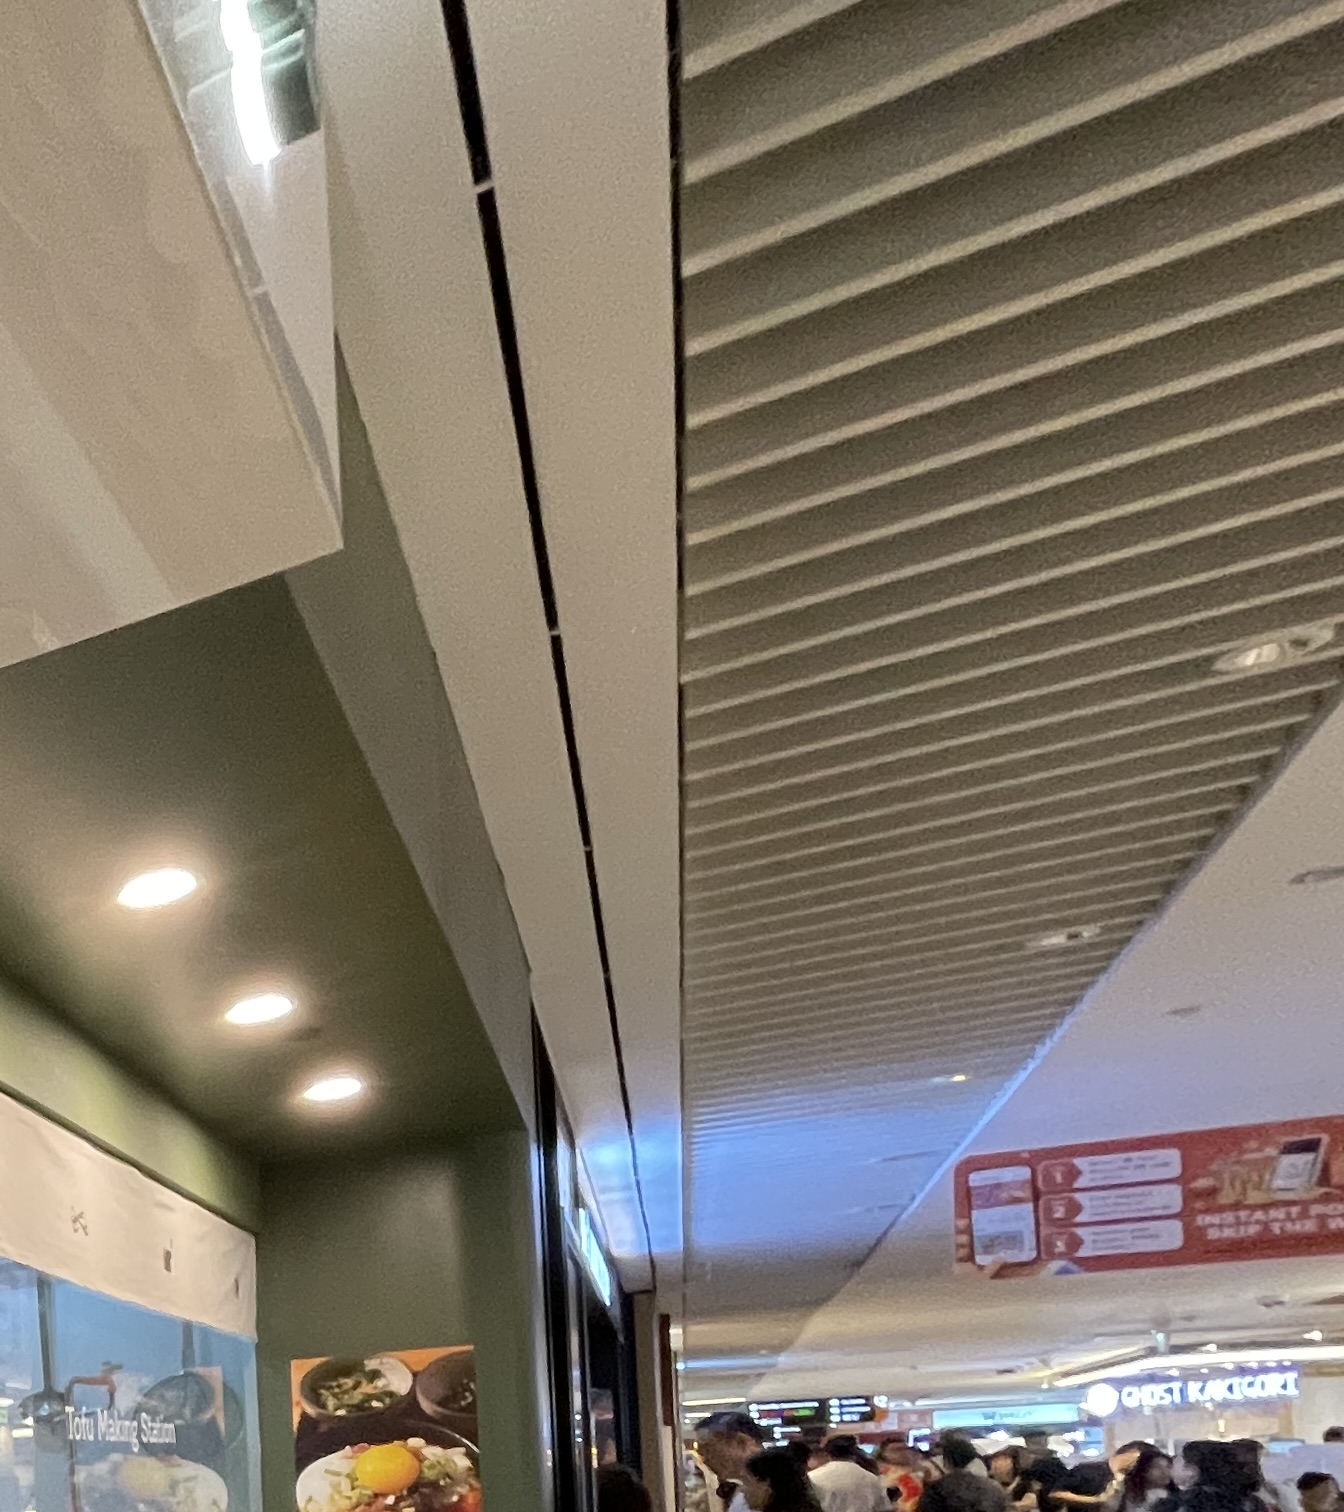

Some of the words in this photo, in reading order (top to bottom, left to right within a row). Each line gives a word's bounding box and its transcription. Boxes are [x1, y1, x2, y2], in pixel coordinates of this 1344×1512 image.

[64, 1405, 95, 1442] Tofu
[97, 1408, 140, 1453] Making
[141, 1411, 177, 1444] Station
